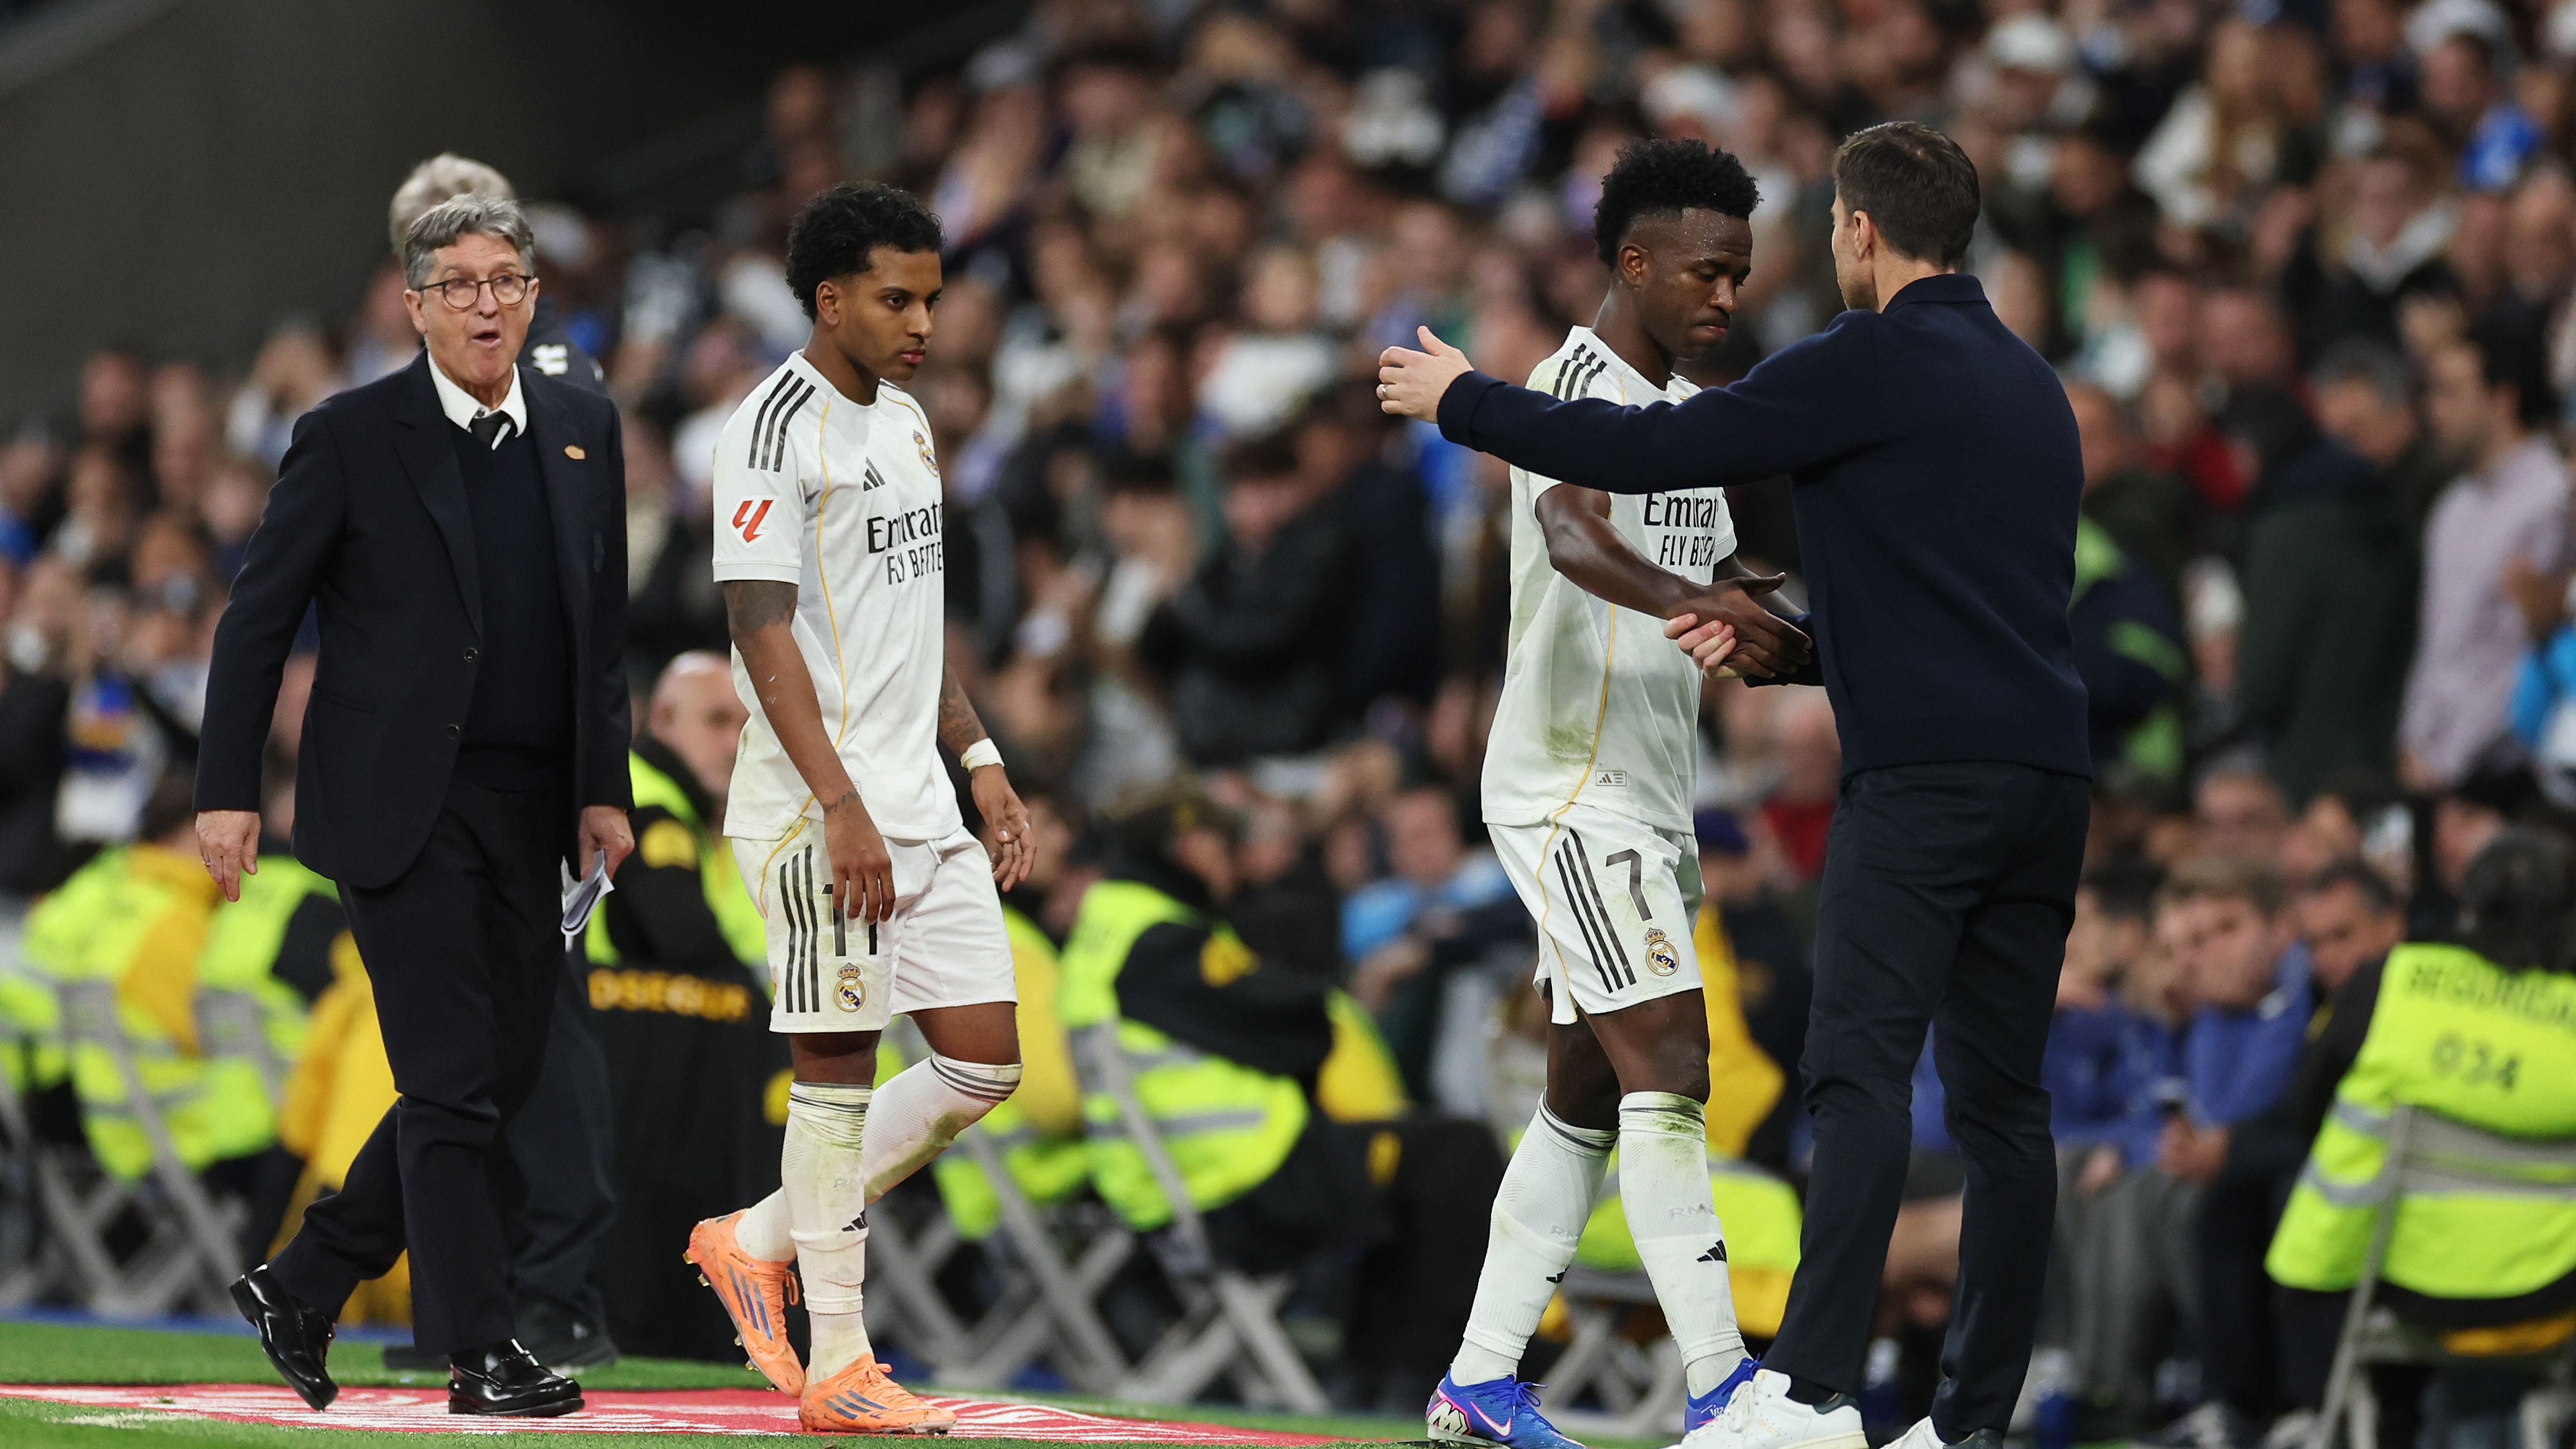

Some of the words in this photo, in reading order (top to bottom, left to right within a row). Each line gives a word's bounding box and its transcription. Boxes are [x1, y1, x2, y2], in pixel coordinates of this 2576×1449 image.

[866, 499, 943, 554] Emirat
[1644, 488, 1718, 528] Emirat
[908, 541, 942, 578] BETTE
[1659, 535, 1687, 565] FLY
[1606, 848, 1653, 922] 7
